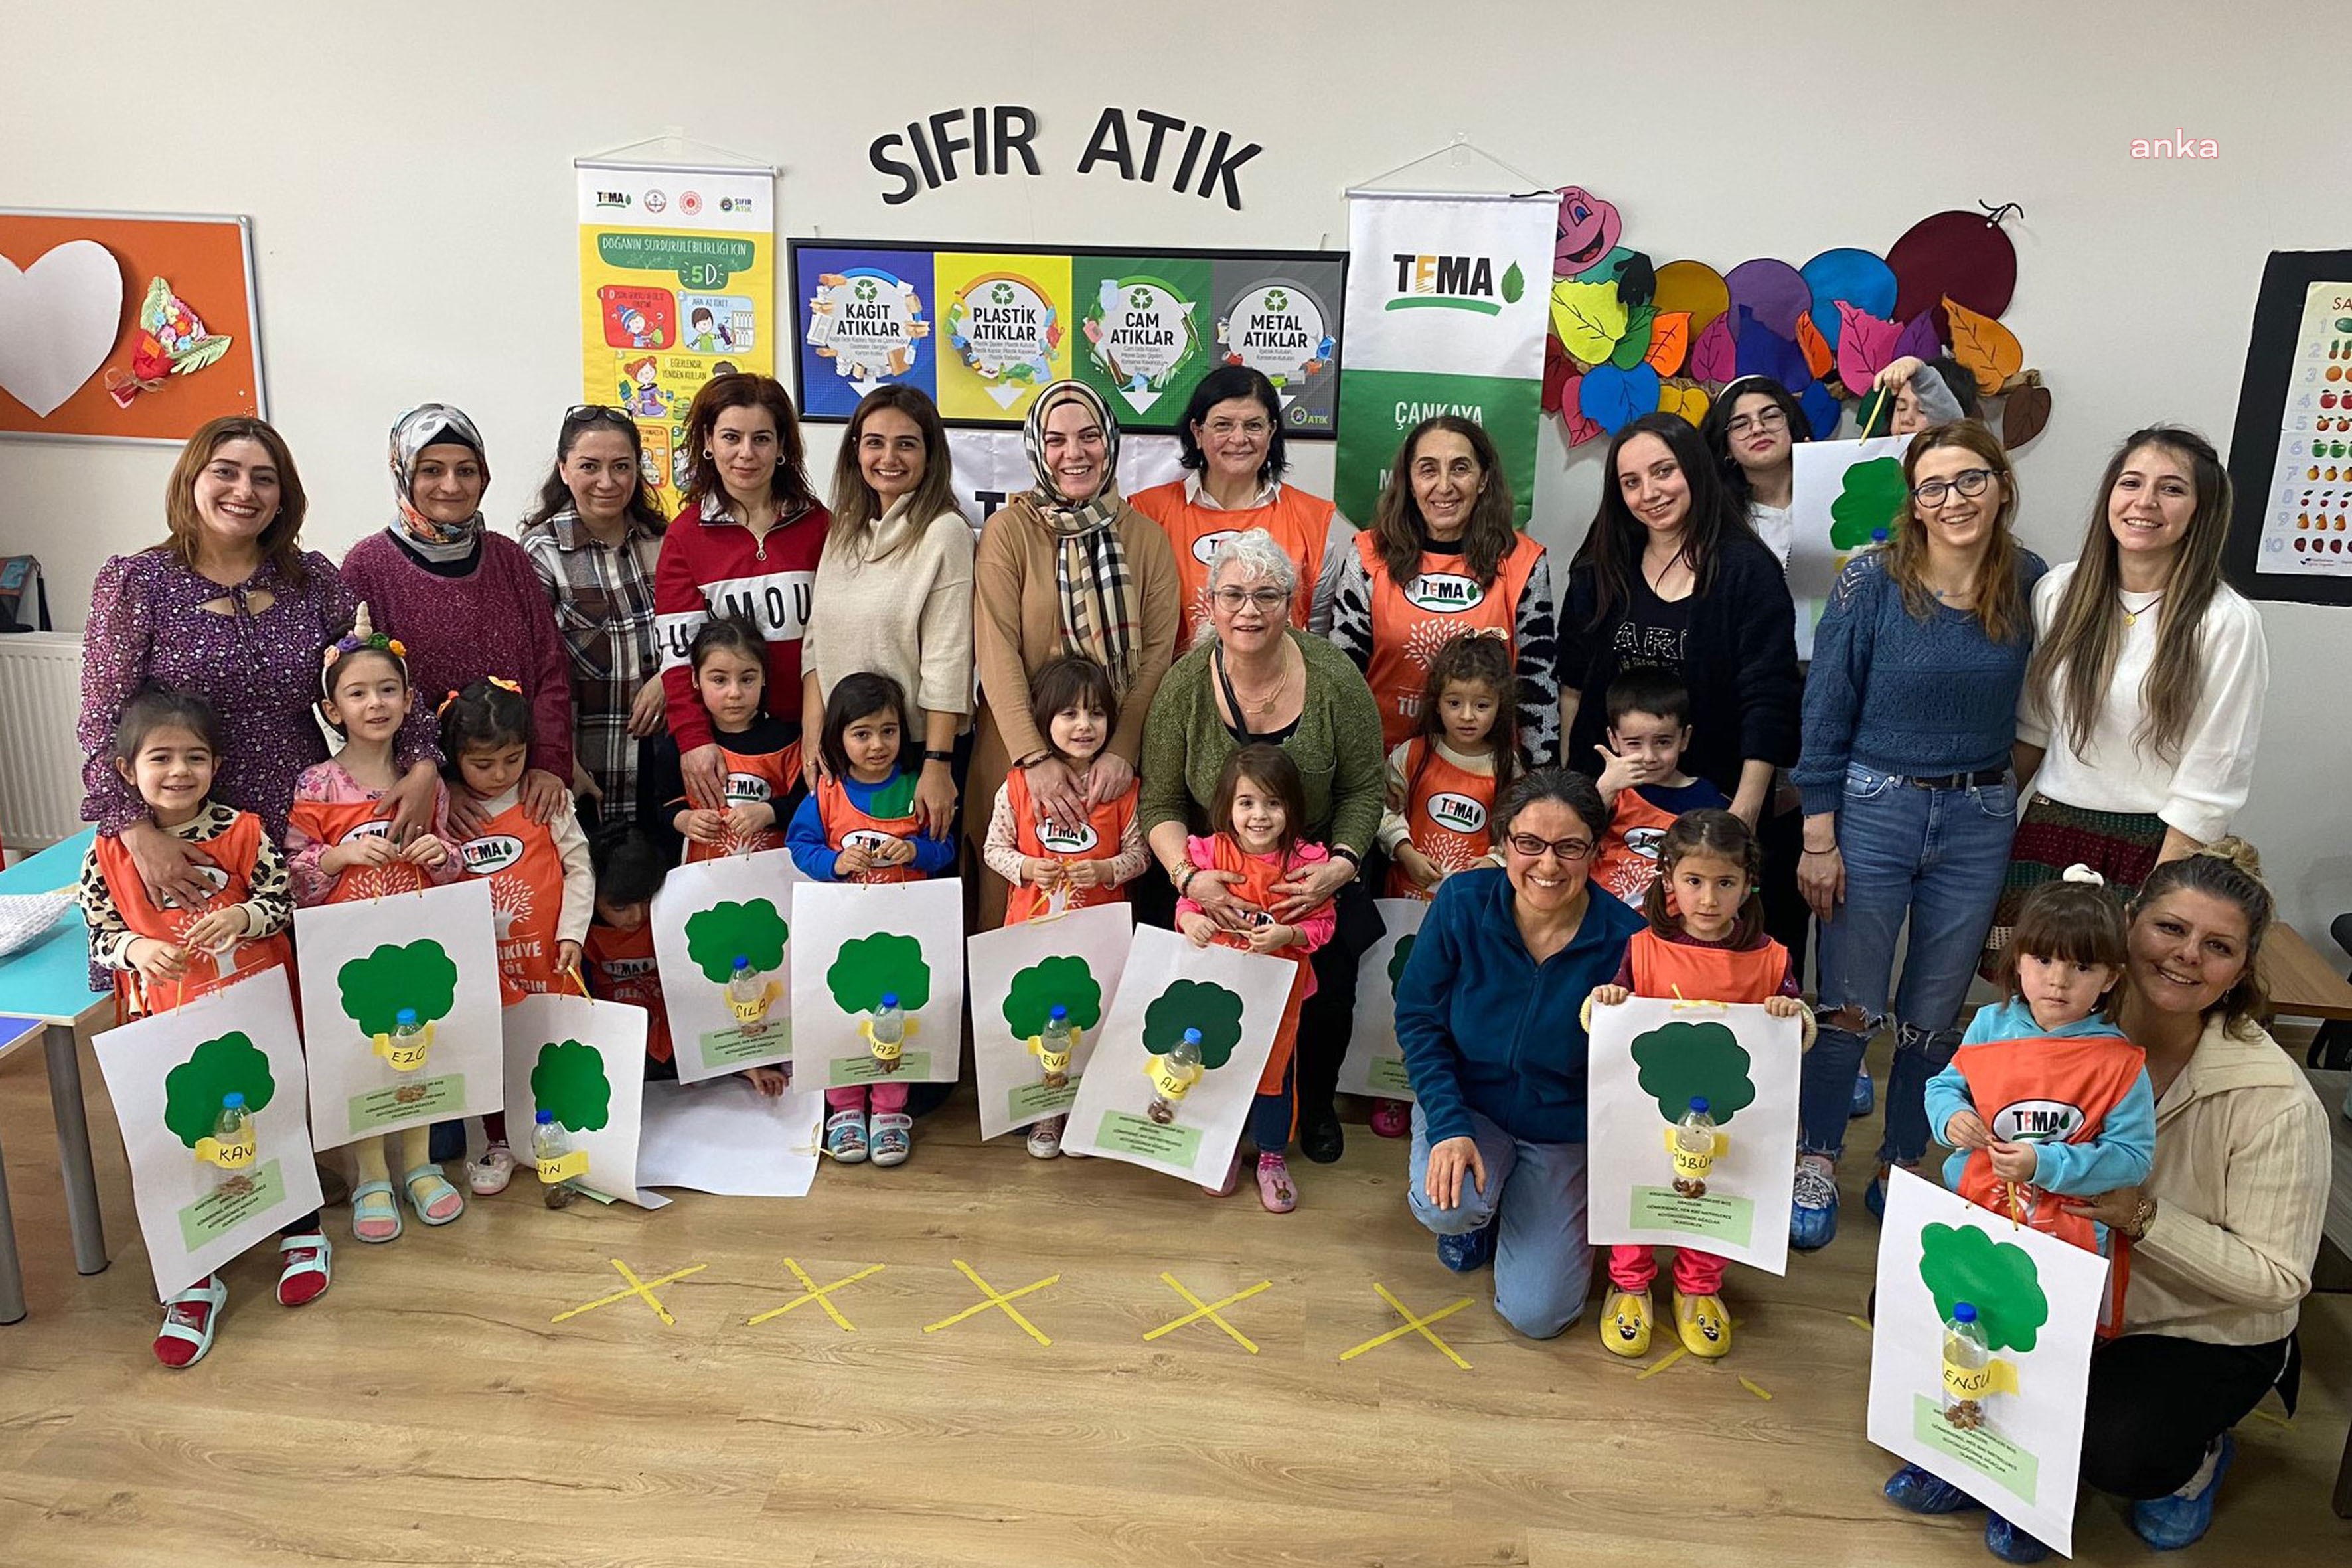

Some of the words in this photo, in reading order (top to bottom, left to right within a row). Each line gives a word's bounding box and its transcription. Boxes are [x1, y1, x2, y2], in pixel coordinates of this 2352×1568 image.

[869, 106, 1041, 205] SIFIR
[1077, 108, 1263, 211] ATIK
[597, 192, 624, 204] TEMA
[1393, 254, 1494, 296] TEMA
[845, 299, 890, 320] KAĞIT
[973, 305, 1036, 325] PLASTİK
[836, 321, 900, 337] ATIKLAR
[1125, 313, 1159, 328] CAM
[1251, 315, 1302, 331] METAL
[973, 325, 1036, 341] ATIKLAR
[1111, 329, 1174, 346] ATIKLAR
[1243, 331, 1308, 348] ATIKLAR
[2308, 343, 2321, 358] 2
[2306, 366, 2317, 382] 3
[2298, 393, 2311, 408] 4
[1395, 402, 1483, 430] ÇANKAYA
[2296, 416, 2307, 430] 5
[2290, 441, 2303, 455] 6
[2278, 511, 2290, 526] 9
[1421, 579, 1463, 599] TEMA
[1441, 797, 1474, 821] TEMA
[464, 842, 501, 862] TEMA
[855, 835, 886, 852] TEM
[1243, 910, 1273, 927] TEM
[2012, 1111, 2059, 1132] TEMA
